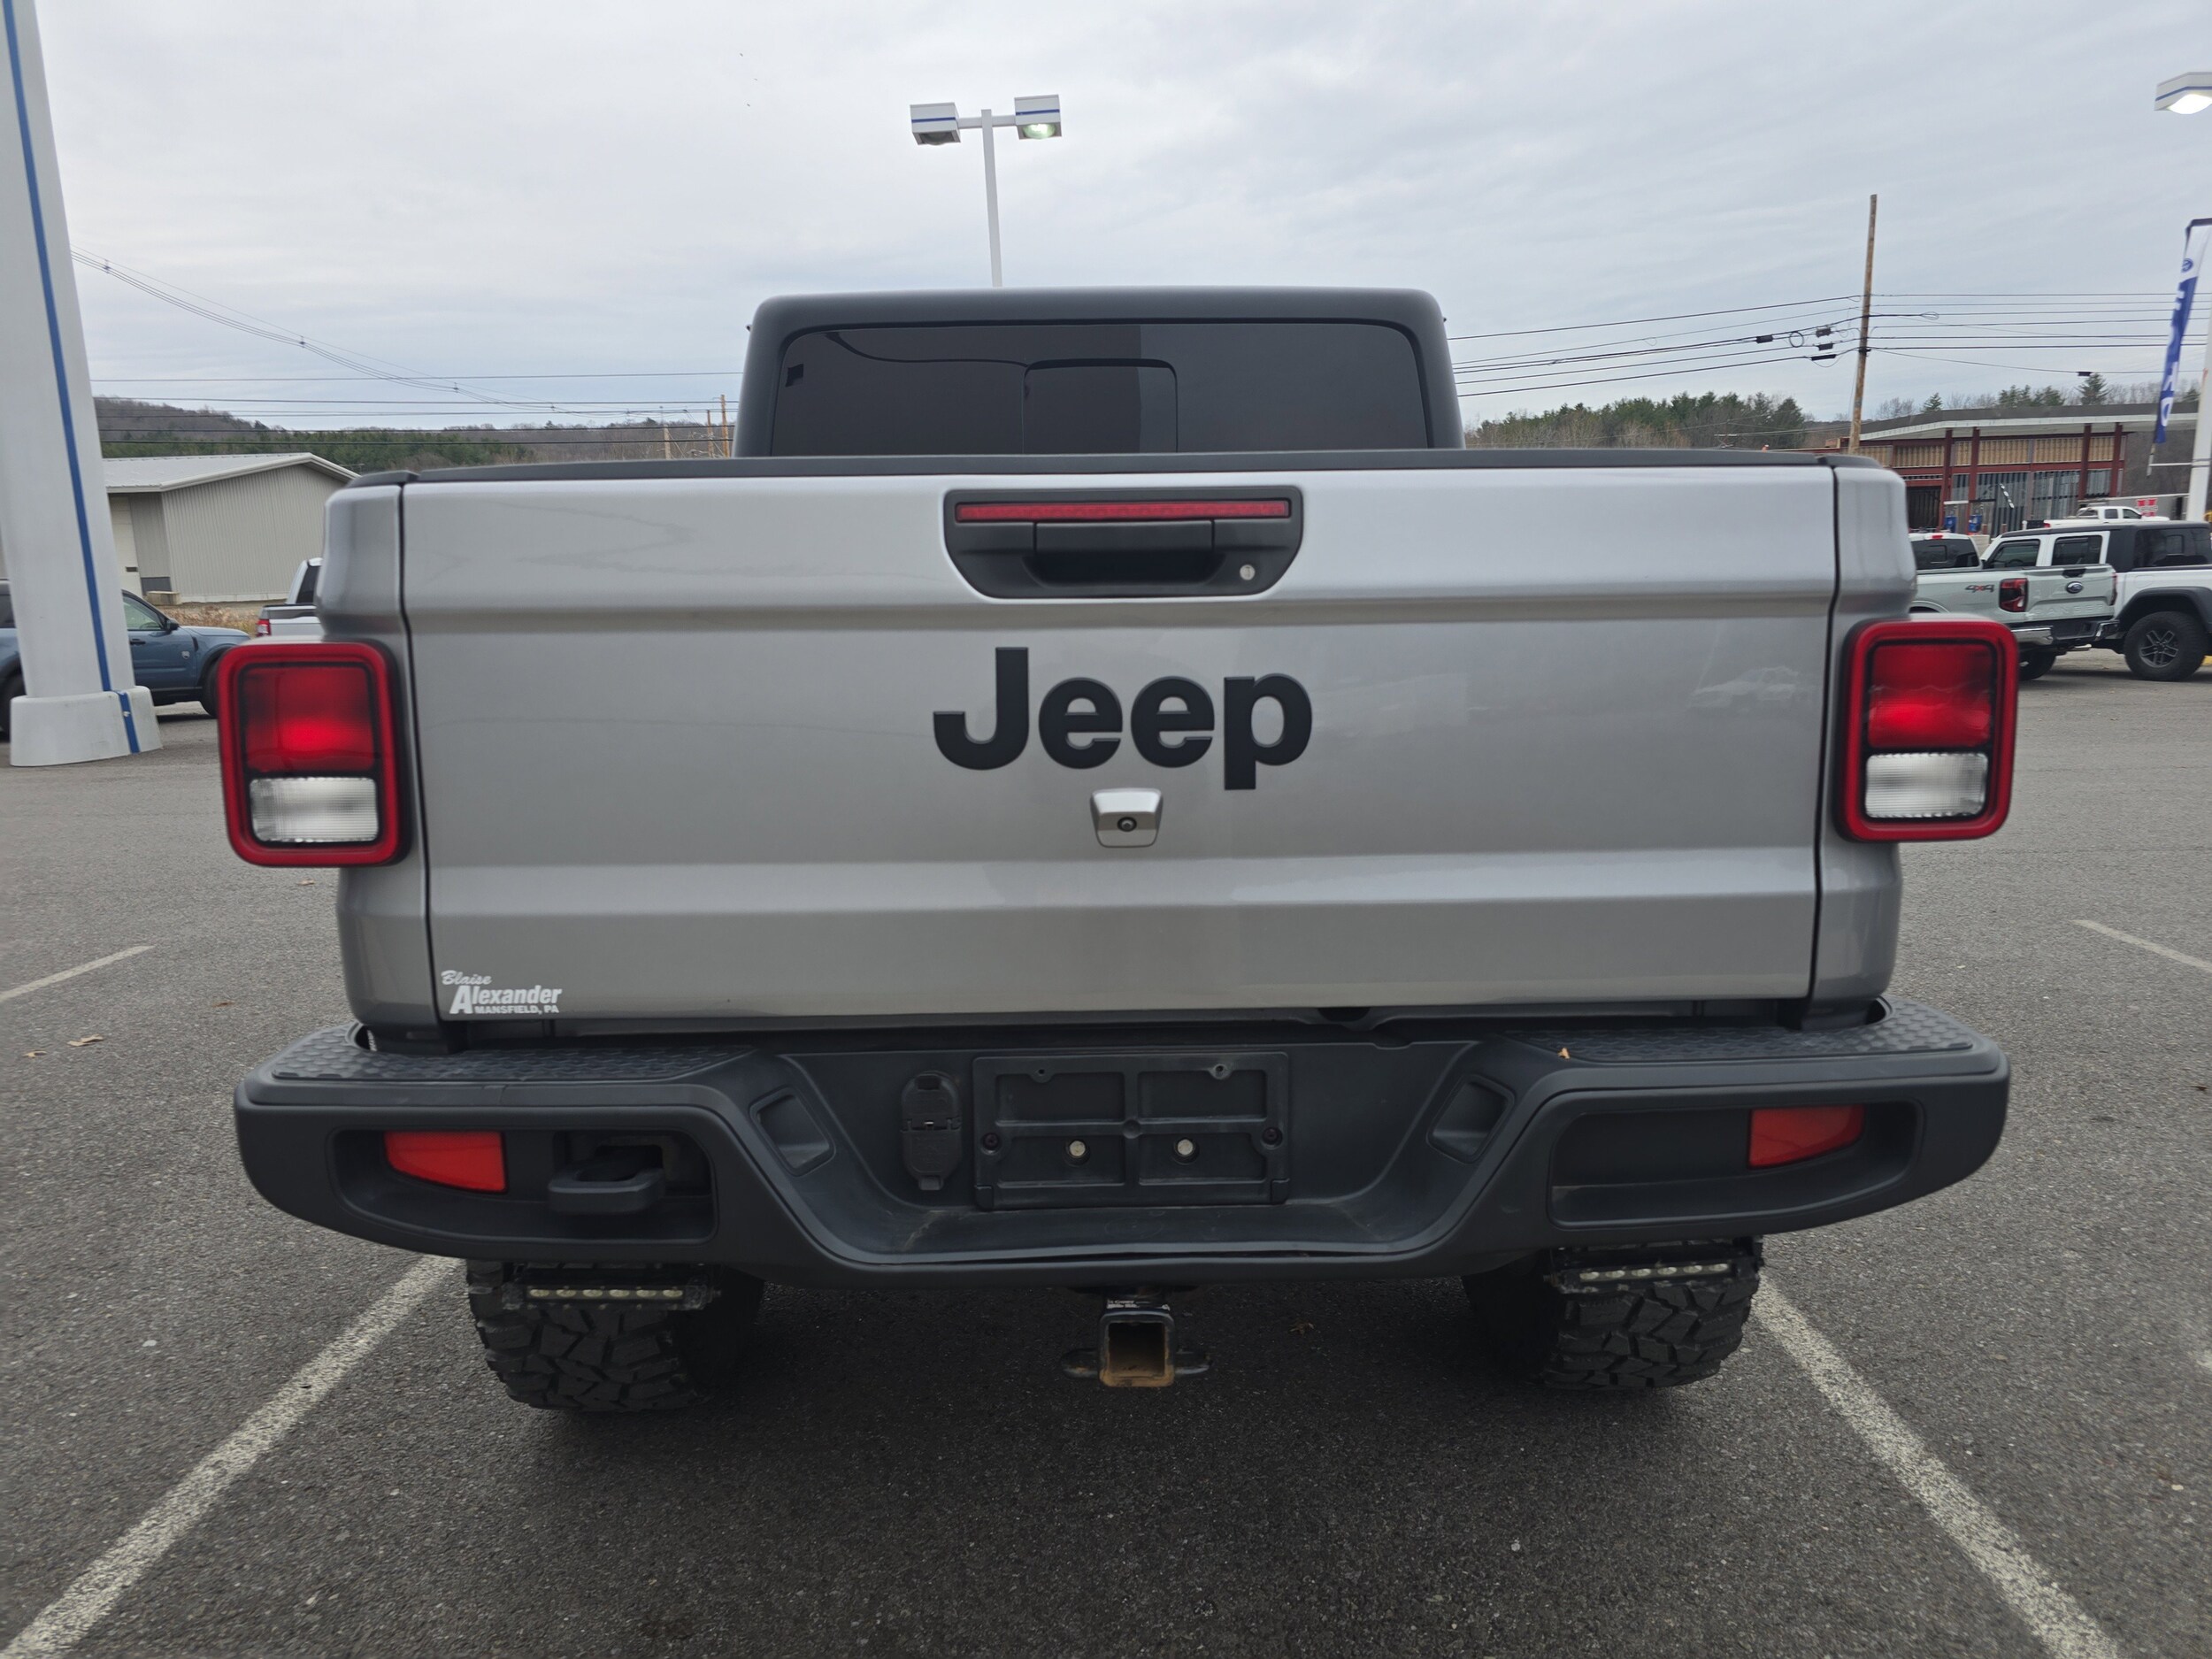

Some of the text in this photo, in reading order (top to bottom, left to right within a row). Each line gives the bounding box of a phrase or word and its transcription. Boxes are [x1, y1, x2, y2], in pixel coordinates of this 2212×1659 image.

[933, 647, 1313, 790] Jeep
[441, 970, 492, 985] Blaise
[449, 985, 563, 1014] Alexander
[474, 1004, 559, 1015] MANSFIELD, PA
